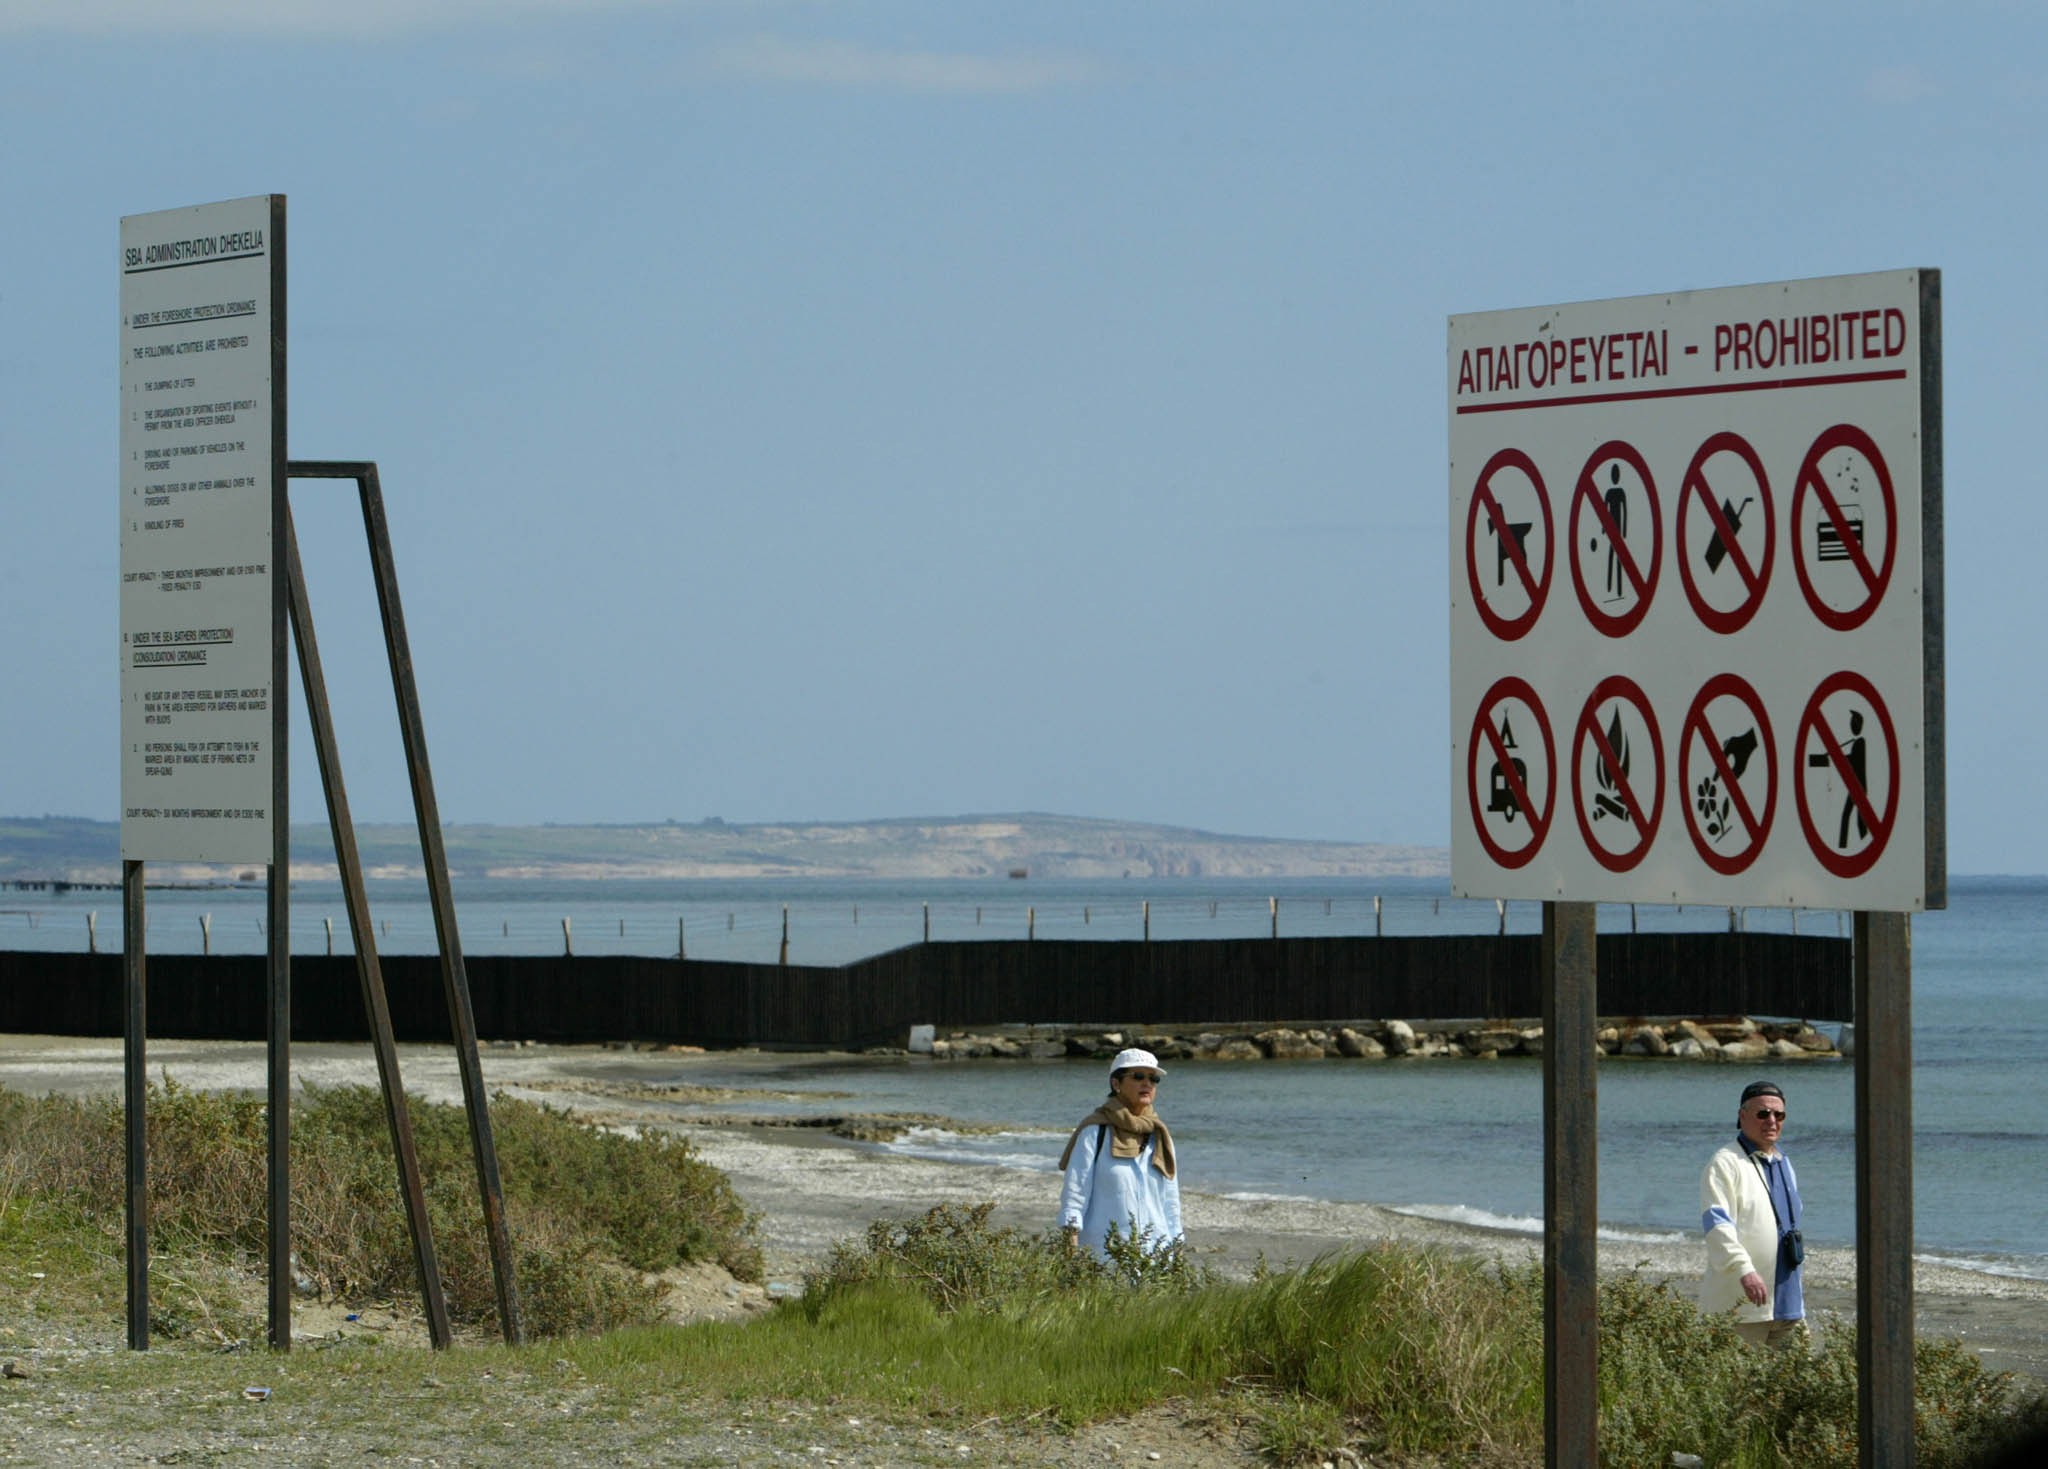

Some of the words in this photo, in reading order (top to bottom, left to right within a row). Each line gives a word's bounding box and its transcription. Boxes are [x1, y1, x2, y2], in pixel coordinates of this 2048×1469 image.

[125, 248, 142, 266] SBA
[146, 238, 216, 263] ADMINISTRATION
[220, 230, 263, 253] DHEKELIA
[133, 313, 149, 324] UNDER
[151, 312, 160, 322] THE
[194, 304, 225, 317] PROTECTION
[227, 300, 256, 312] ORDINANCE
[133, 349, 143, 359] THE
[145, 345, 174, 357] FOLLOWING
[206, 340, 215, 351] ARE
[217, 336, 248, 349] PROHIBITED
[1457, 330, 1668, 394] ΑΠΑΓΟΡΕΥΕΤΑΙ
[1715, 307, 1906, 371] PROHIBITED
[133, 632, 149, 643] UNDER
[152, 631, 161, 642] THE
[178, 650, 207, 661] ORDINANCE
